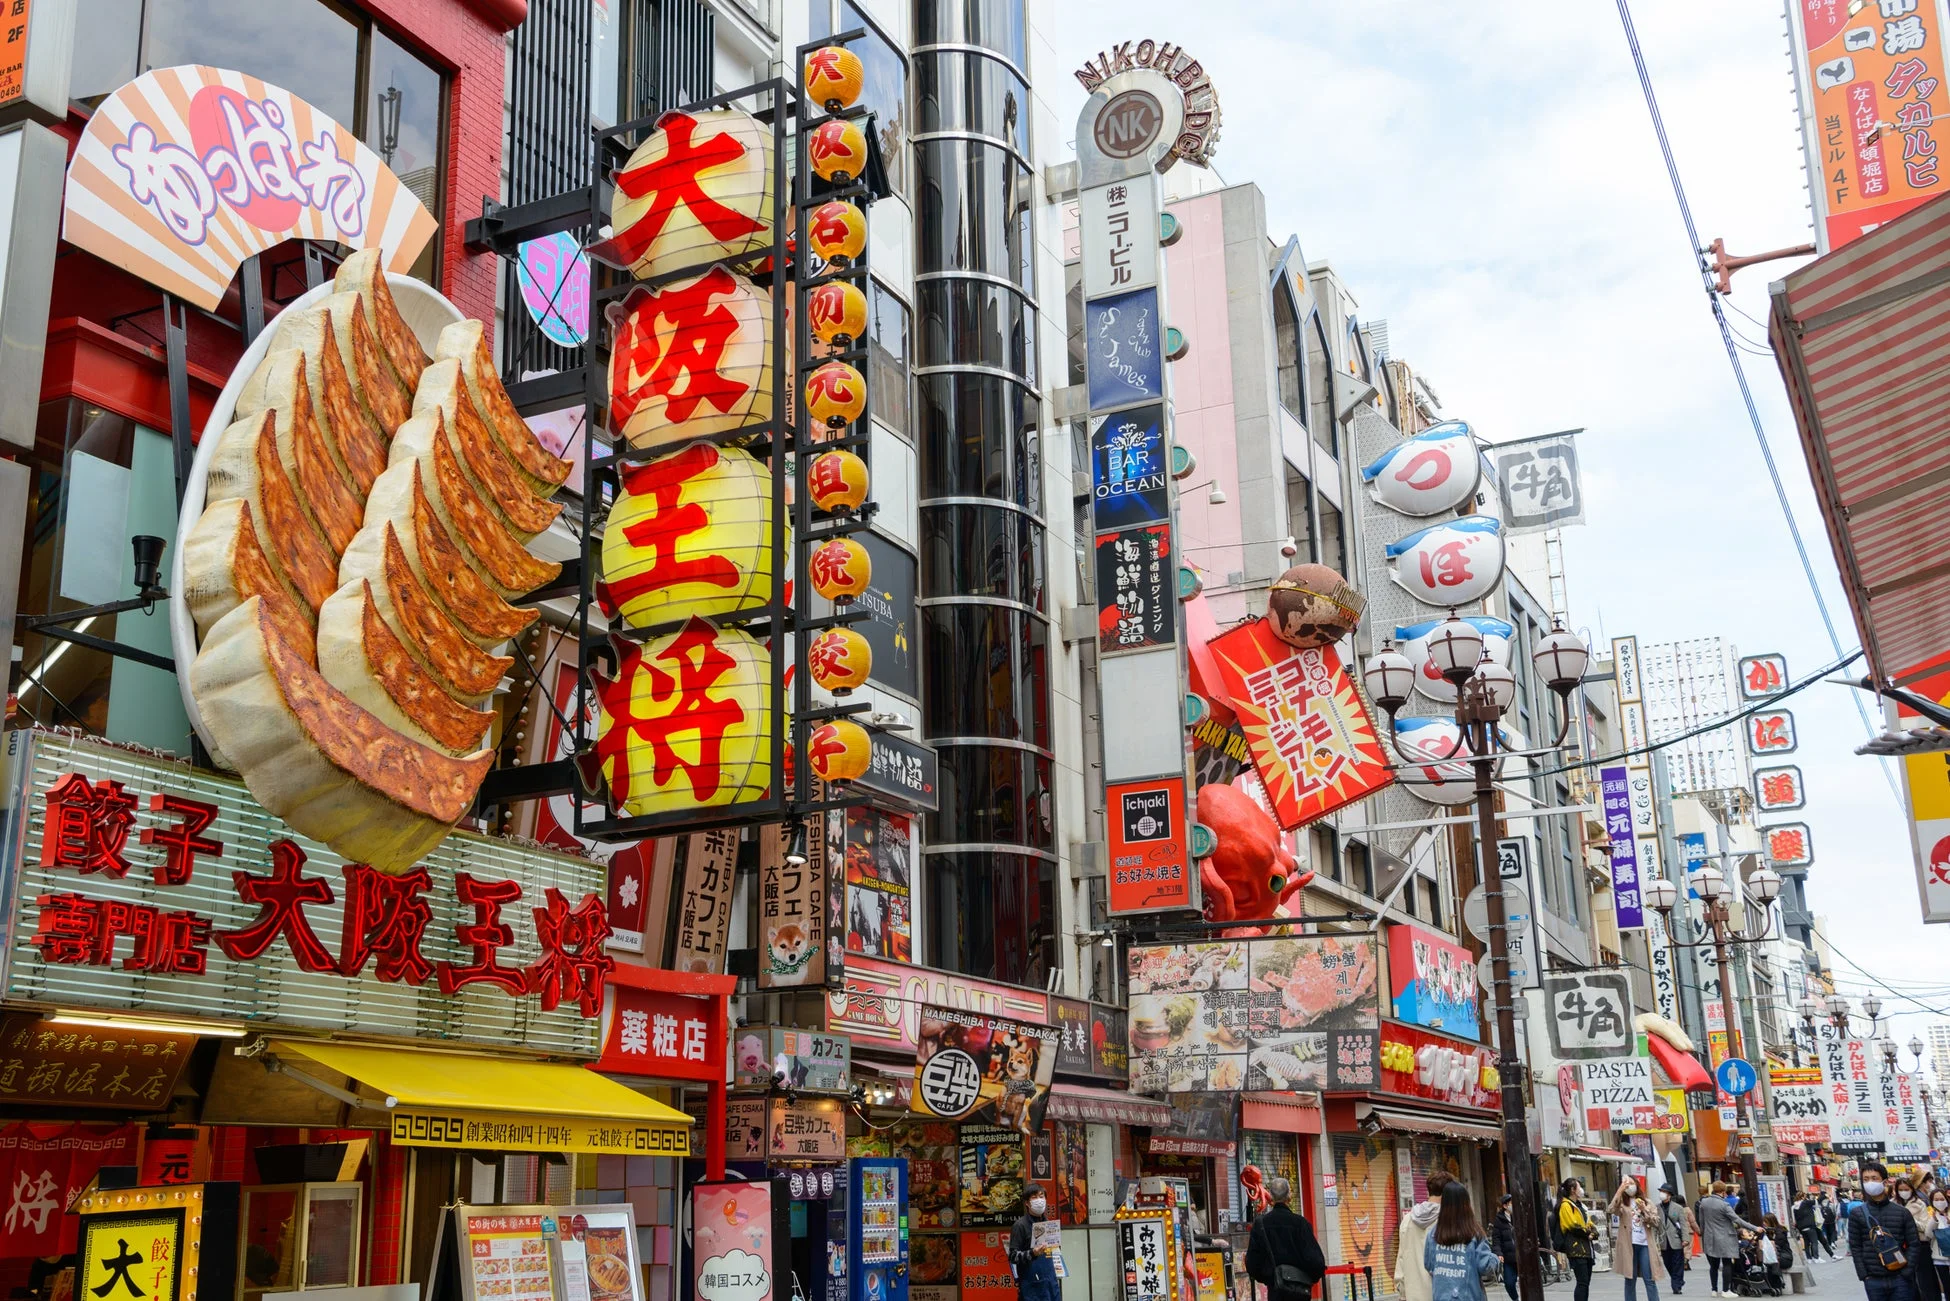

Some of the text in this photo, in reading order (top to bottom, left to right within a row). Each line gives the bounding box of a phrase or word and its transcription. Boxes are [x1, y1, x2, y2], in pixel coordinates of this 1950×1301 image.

[8, 25, 24, 44] 2F
[1073, 38, 1183, 95] NIKOH
[1108, 107, 1148, 146] NK
[1163, 217, 1173, 233] 5
[574, 110, 769, 815] 大阪王将
[1109, 450, 1149, 471] BAR
[1096, 473, 1166, 499] OCEAN
[1510, 463, 1573, 507] 牛角
[1394, 442, 1480, 788] づぼや
[1604, 781, 1626, 793] 元祖
[40, 772, 223, 886] 餃子
[1116, 865, 1183, 884] お好み焼き
[764, 866, 780, 918] 大阪店
[212, 838, 617, 1019] 大阪王将
[681, 890, 698, 949] 大阪店
[713, 901, 727, 956] CAFE
[810, 890, 821, 941] CAFE
[924, 1008, 1057, 1043] MAMESHIBA CAFE OSAKA
[1557, 991, 1625, 1039] 牛角
[621, 1008, 708, 1062] 薬粧店
[1586, 1061, 1648, 1080] PASTA
[1611, 1079, 1622, 1088] &
[936, 1101, 955, 1111] CAFE
[1590, 1087, 1650, 1104] PIZZA
[785, 1114, 831, 1135] 豆柴カフェ
[1634, 1112, 1655, 1124] 2F
[466, 1120, 572, 1147] 創業昭和四十四年
[586, 1128, 634, 1148] 元祖餃子
[90, 1238, 147, 1298] 大
[1435, 1253, 1466, 1266] WILL BE
[704, 1271, 766, 1288] 韓国コスメ
[1433, 1268, 1467, 1279] DIFFERENT
